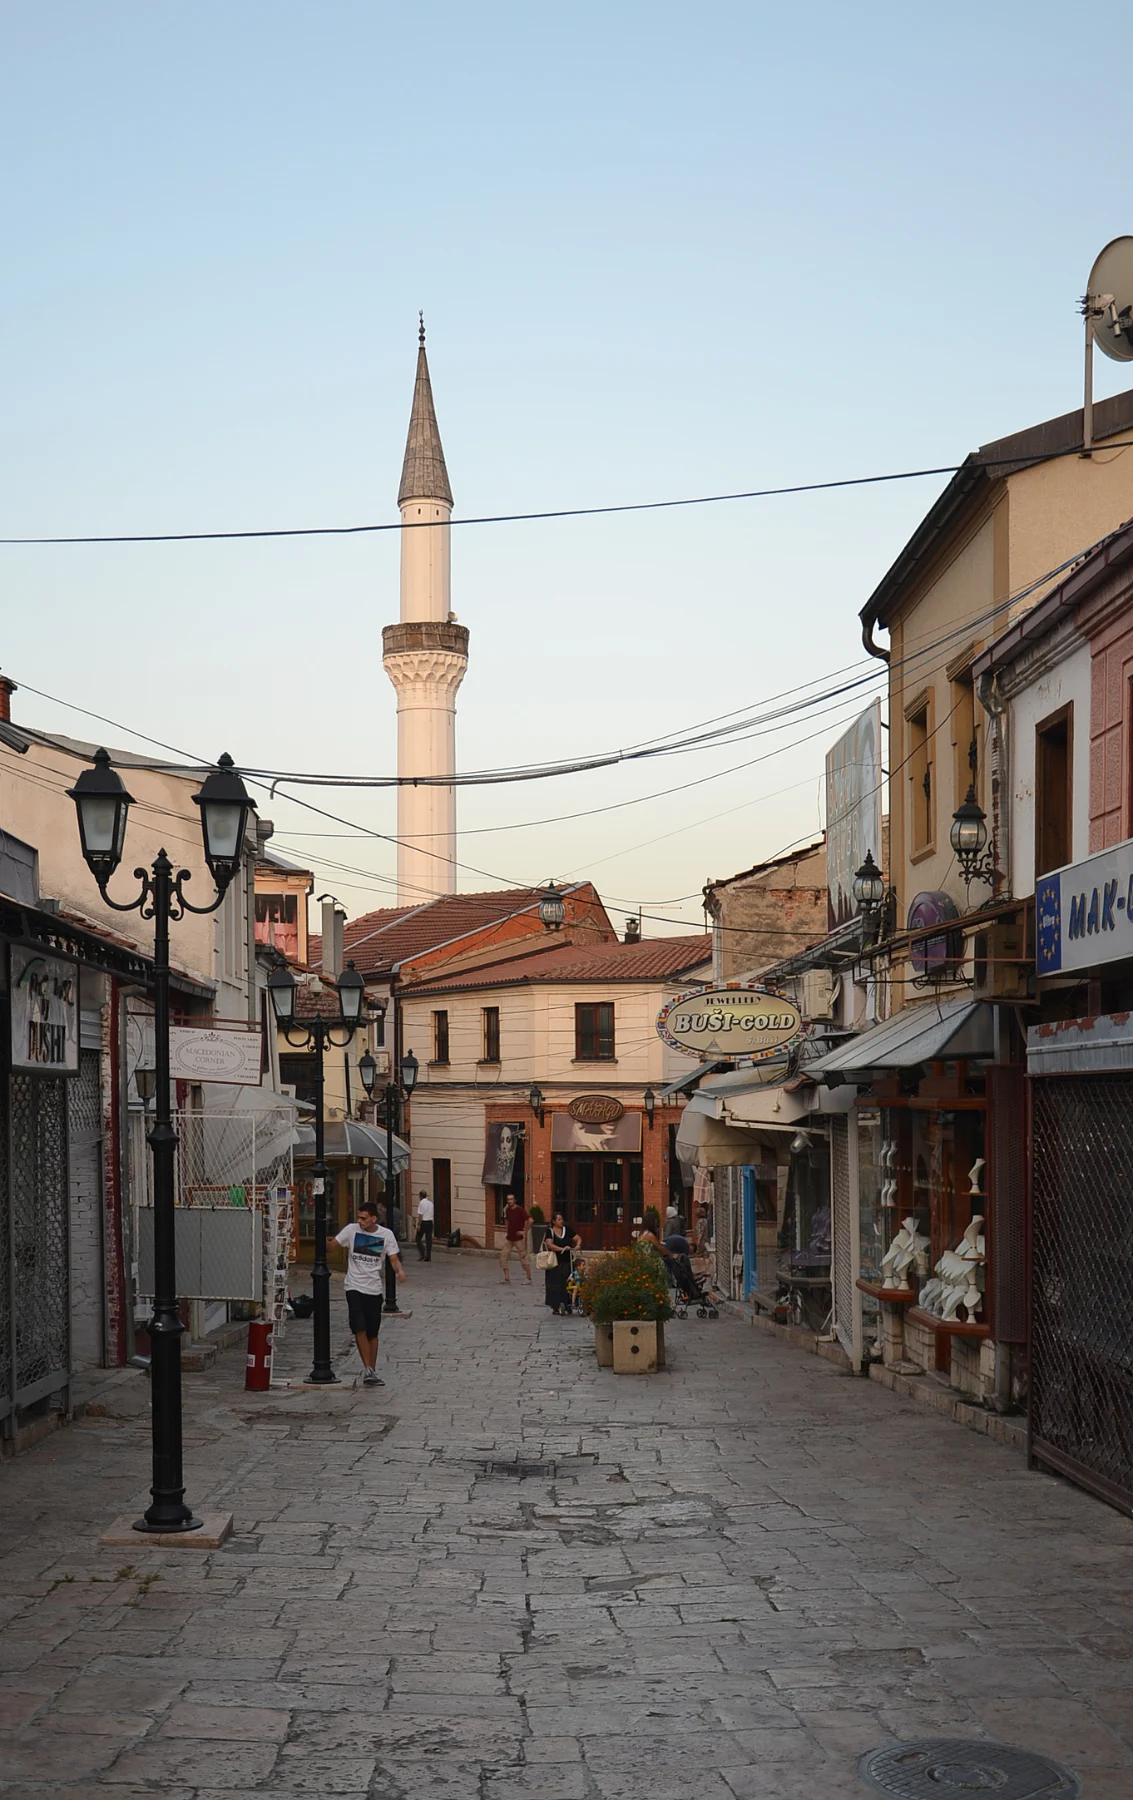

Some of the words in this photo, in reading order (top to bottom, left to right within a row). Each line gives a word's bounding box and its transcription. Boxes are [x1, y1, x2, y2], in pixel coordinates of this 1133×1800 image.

[674, 1008, 795, 1033] BUŠI-GOLD
[185, 1047, 236, 1057] MACEDONIAN
[195, 1056, 225, 1065] CORNER
[571, 1100, 620, 1120] SMARAGD
